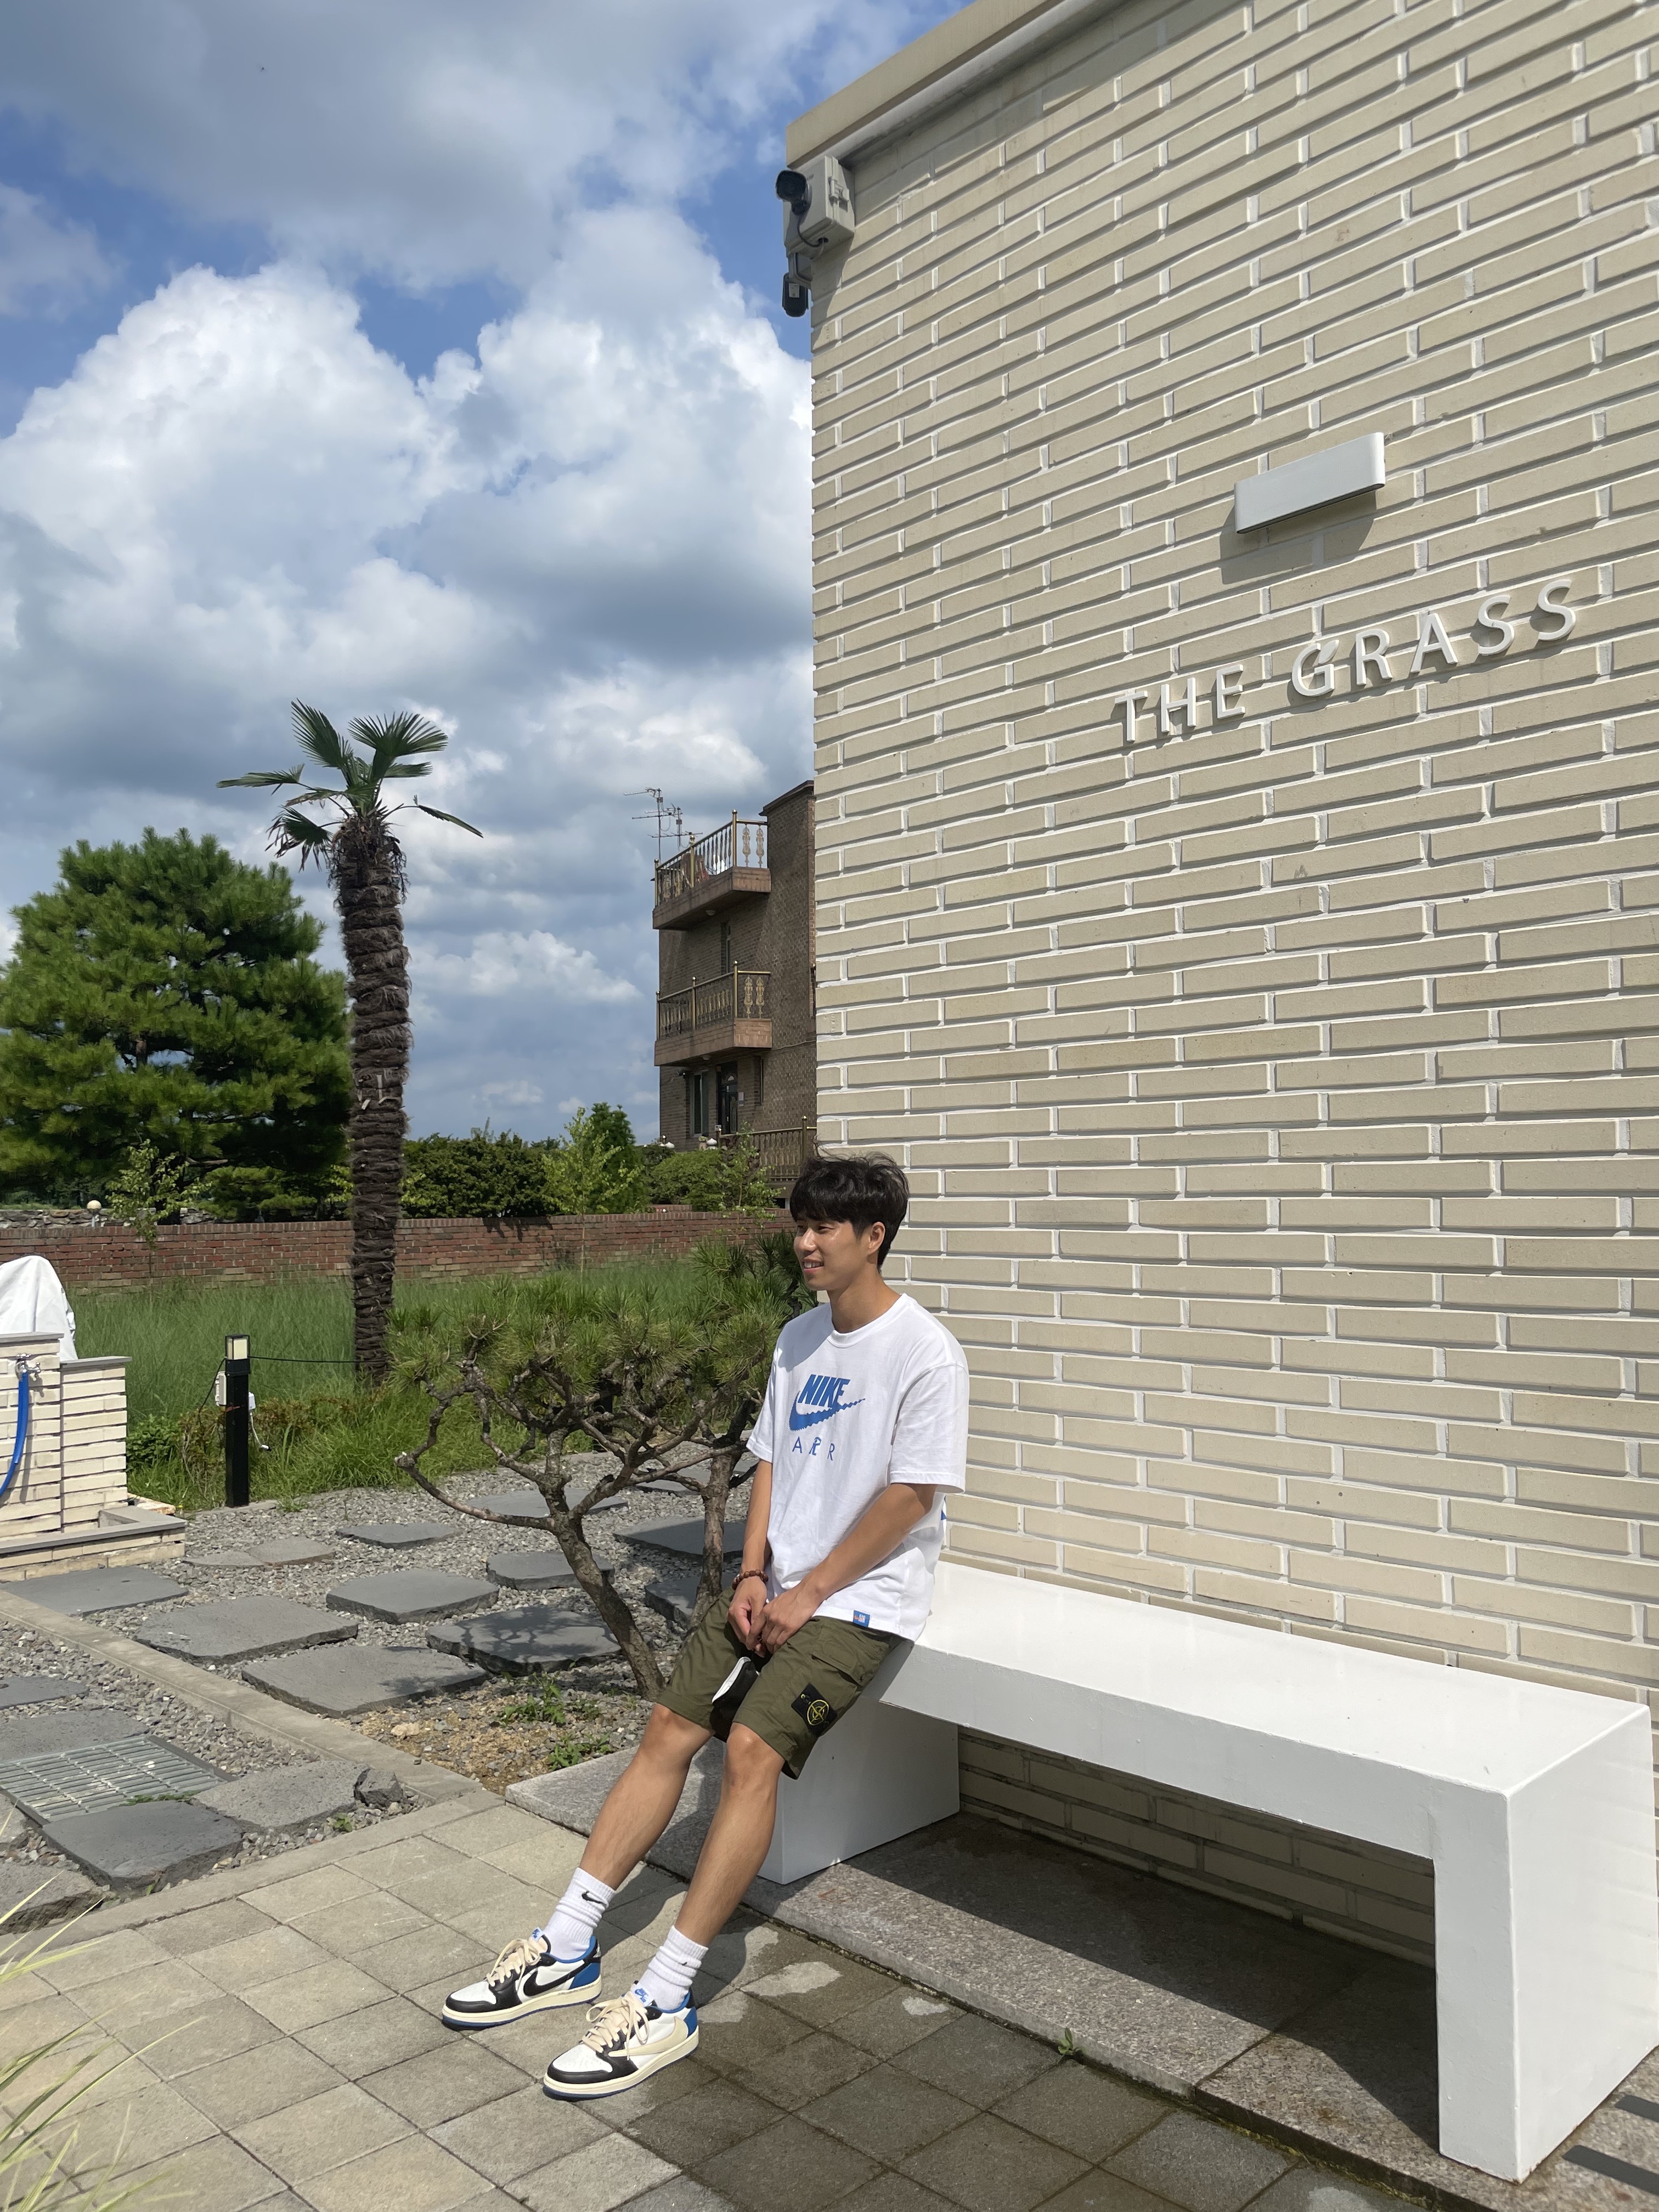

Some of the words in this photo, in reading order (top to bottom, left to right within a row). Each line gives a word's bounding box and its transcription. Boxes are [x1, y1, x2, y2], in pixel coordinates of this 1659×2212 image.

[1115, 664, 1245, 742] THE
[1291, 579, 1576, 697] GRASS
[798, 1374, 851, 1407] NIKE
